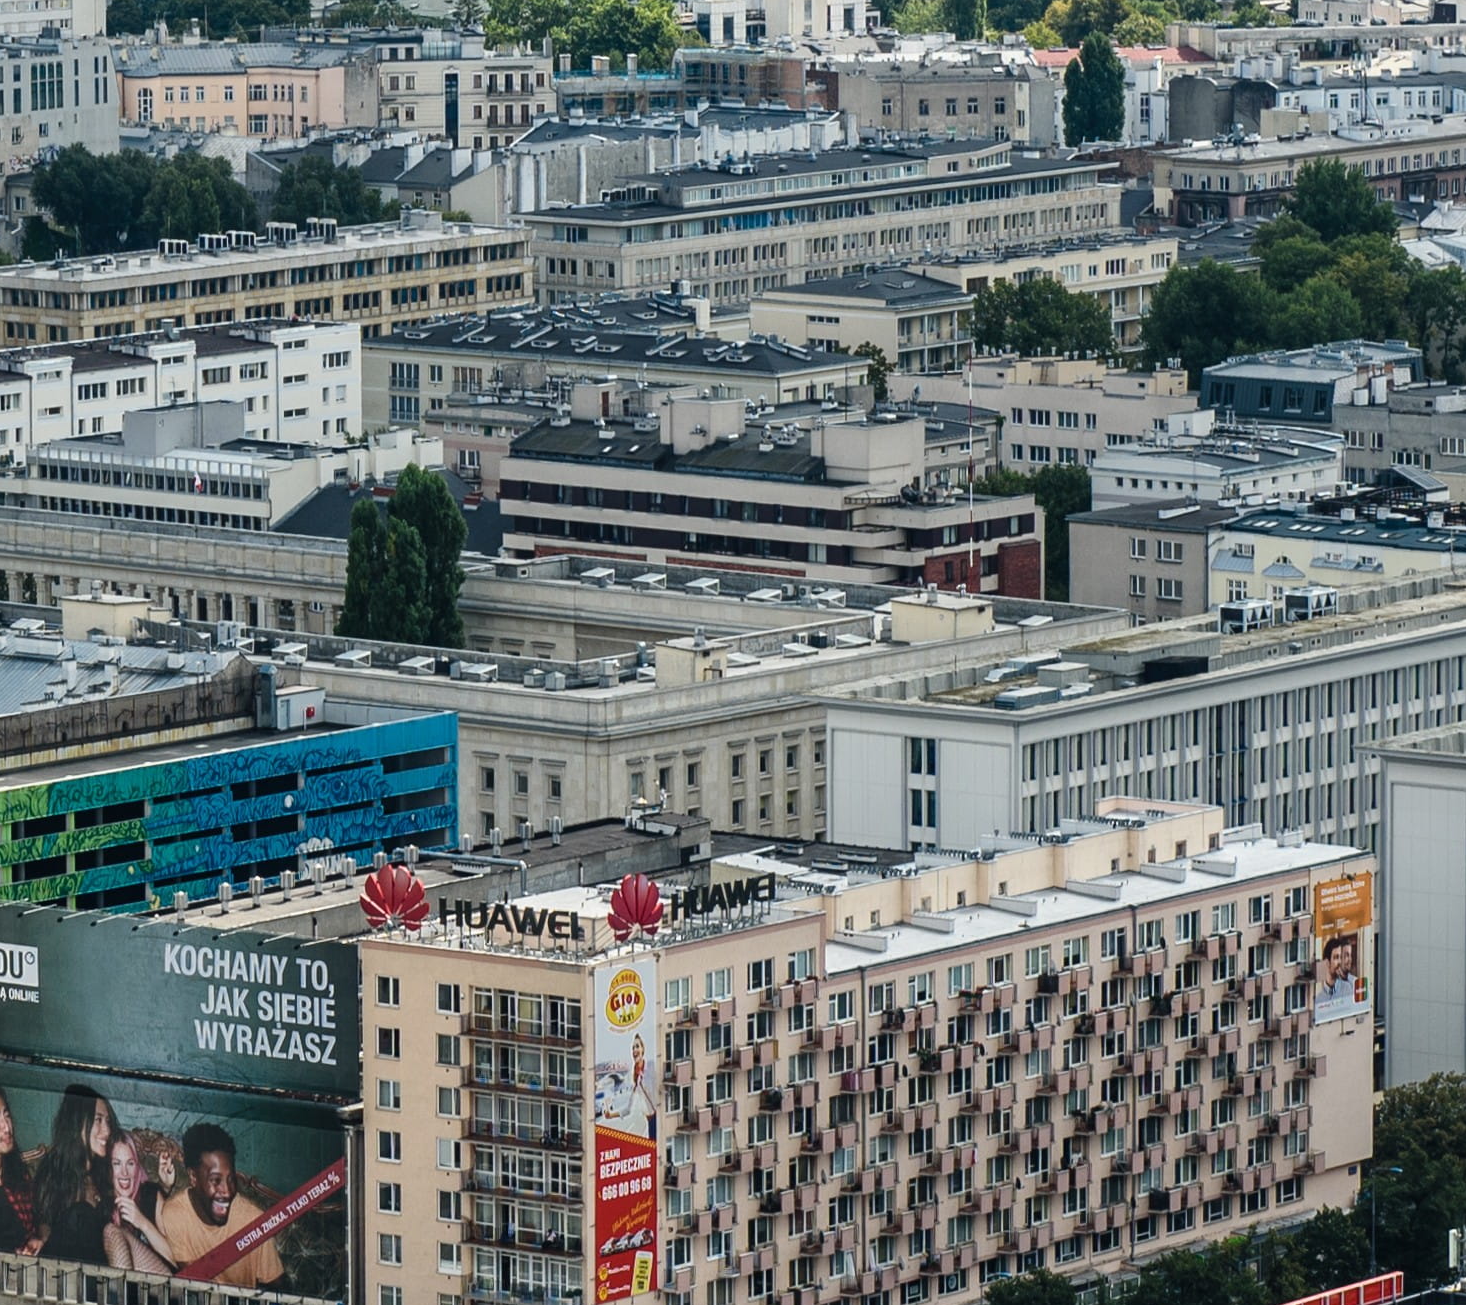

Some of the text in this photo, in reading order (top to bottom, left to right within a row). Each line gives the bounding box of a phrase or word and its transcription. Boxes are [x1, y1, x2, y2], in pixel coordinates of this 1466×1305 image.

[439, 896, 580, 941] HUAWEI
[671, 872, 776, 922] HUAWEI
[164, 942, 335, 998] KOCHAMY TO,
[8, 988, 40, 1004] ONLINE
[200, 984, 336, 1029] JAK SIEBIE
[609, 990, 641, 1013] Glob
[194, 1018, 337, 1066] WYRAŻASZ
[600, 1153, 652, 1179] BEZPIECZNIE
[601, 1184, 617, 1201] 666
[619, 1182, 629, 1197] 00
[236, 1224, 263, 1252] EKSTRA
[285, 1196, 309, 1221] TYLKO
[307, 1180, 331, 1205] TERAZ
